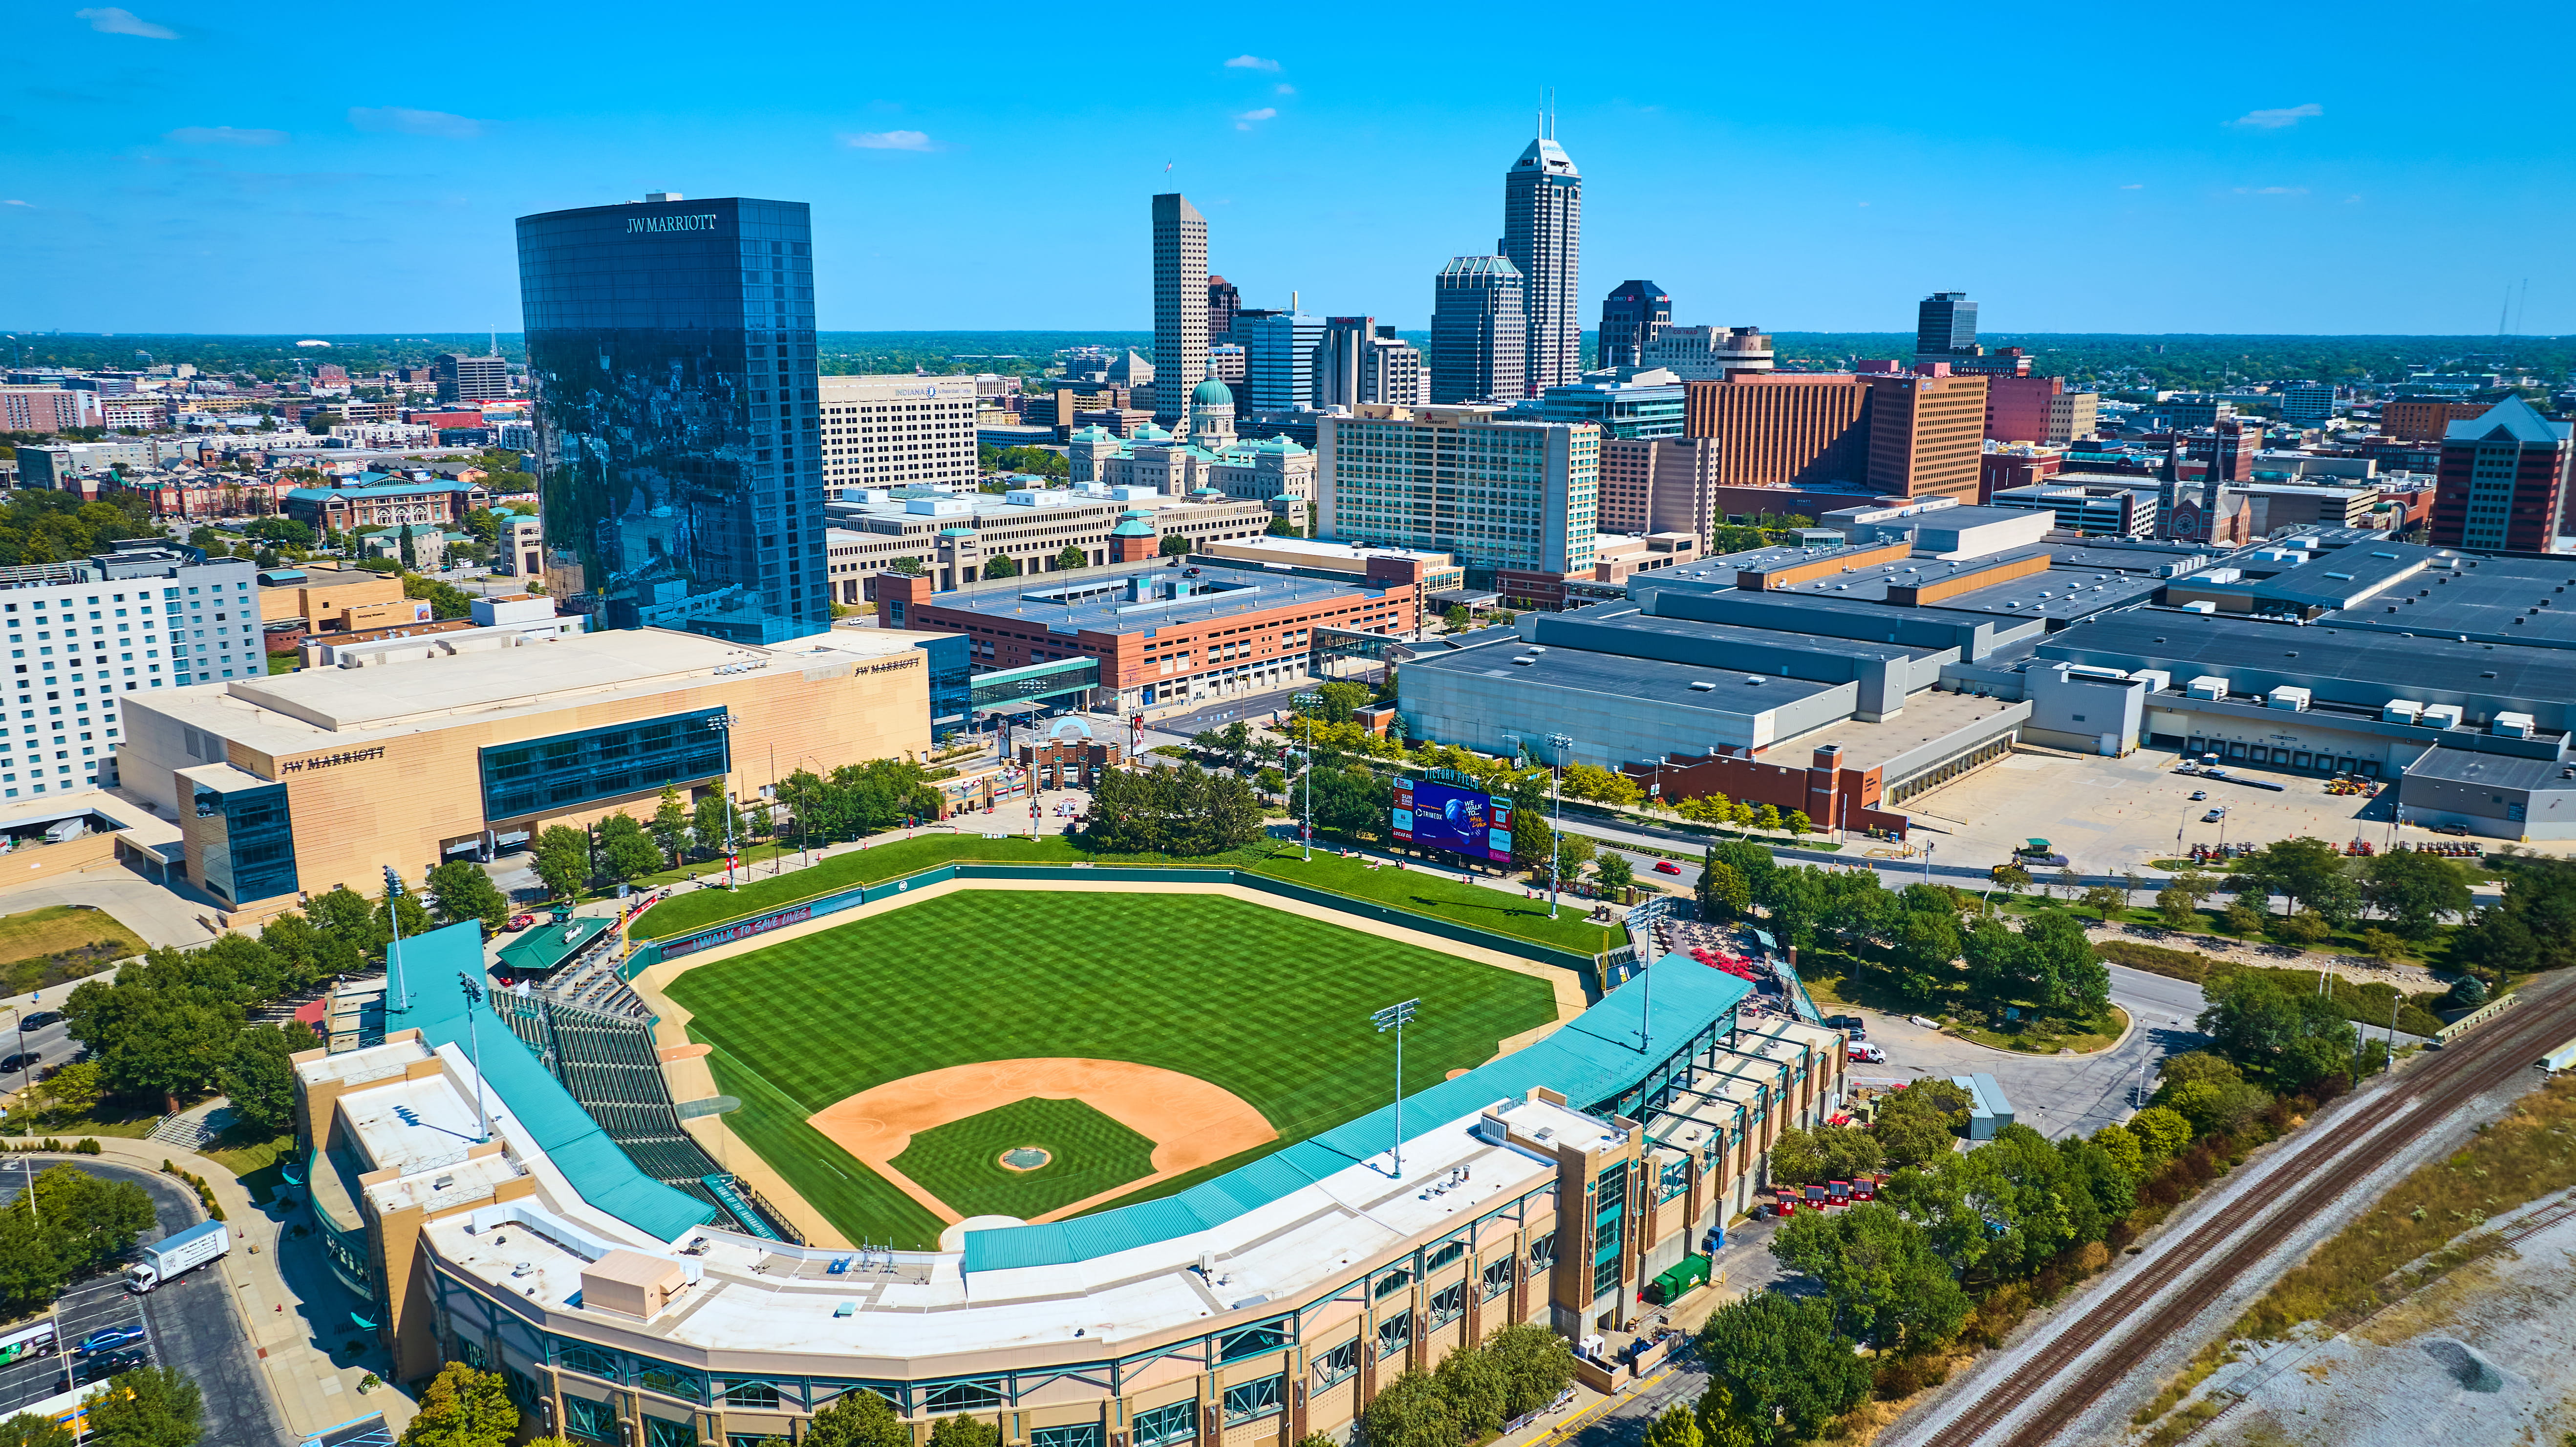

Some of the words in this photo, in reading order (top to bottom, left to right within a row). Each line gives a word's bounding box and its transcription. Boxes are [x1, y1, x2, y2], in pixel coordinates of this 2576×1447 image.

[627, 218, 645, 233] JW
[646, 214, 716, 233] MARRIOTT
[855, 665, 870, 677] JW
[871, 657, 921, 674] MARRIOTT
[281, 759, 304, 774] JW
[307, 746, 386, 770] MARRIOTT
[1425, 769, 1455, 781] VICTORY
[1458, 771, 1479, 789] FIELD
[692, 939, 697, 950] I
[698, 929, 735, 947] WALK
[738, 925, 751, 936] TO
[754, 917, 778, 931] SAVE
[781, 907, 807, 924] LIVES
[716, 1186, 731, 1198] HOME
[732, 1202, 745, 1211] THE
[740, 1210, 771, 1237] INDIANAPOLIS
[1546, 1431, 1572, 1447] PARKING
